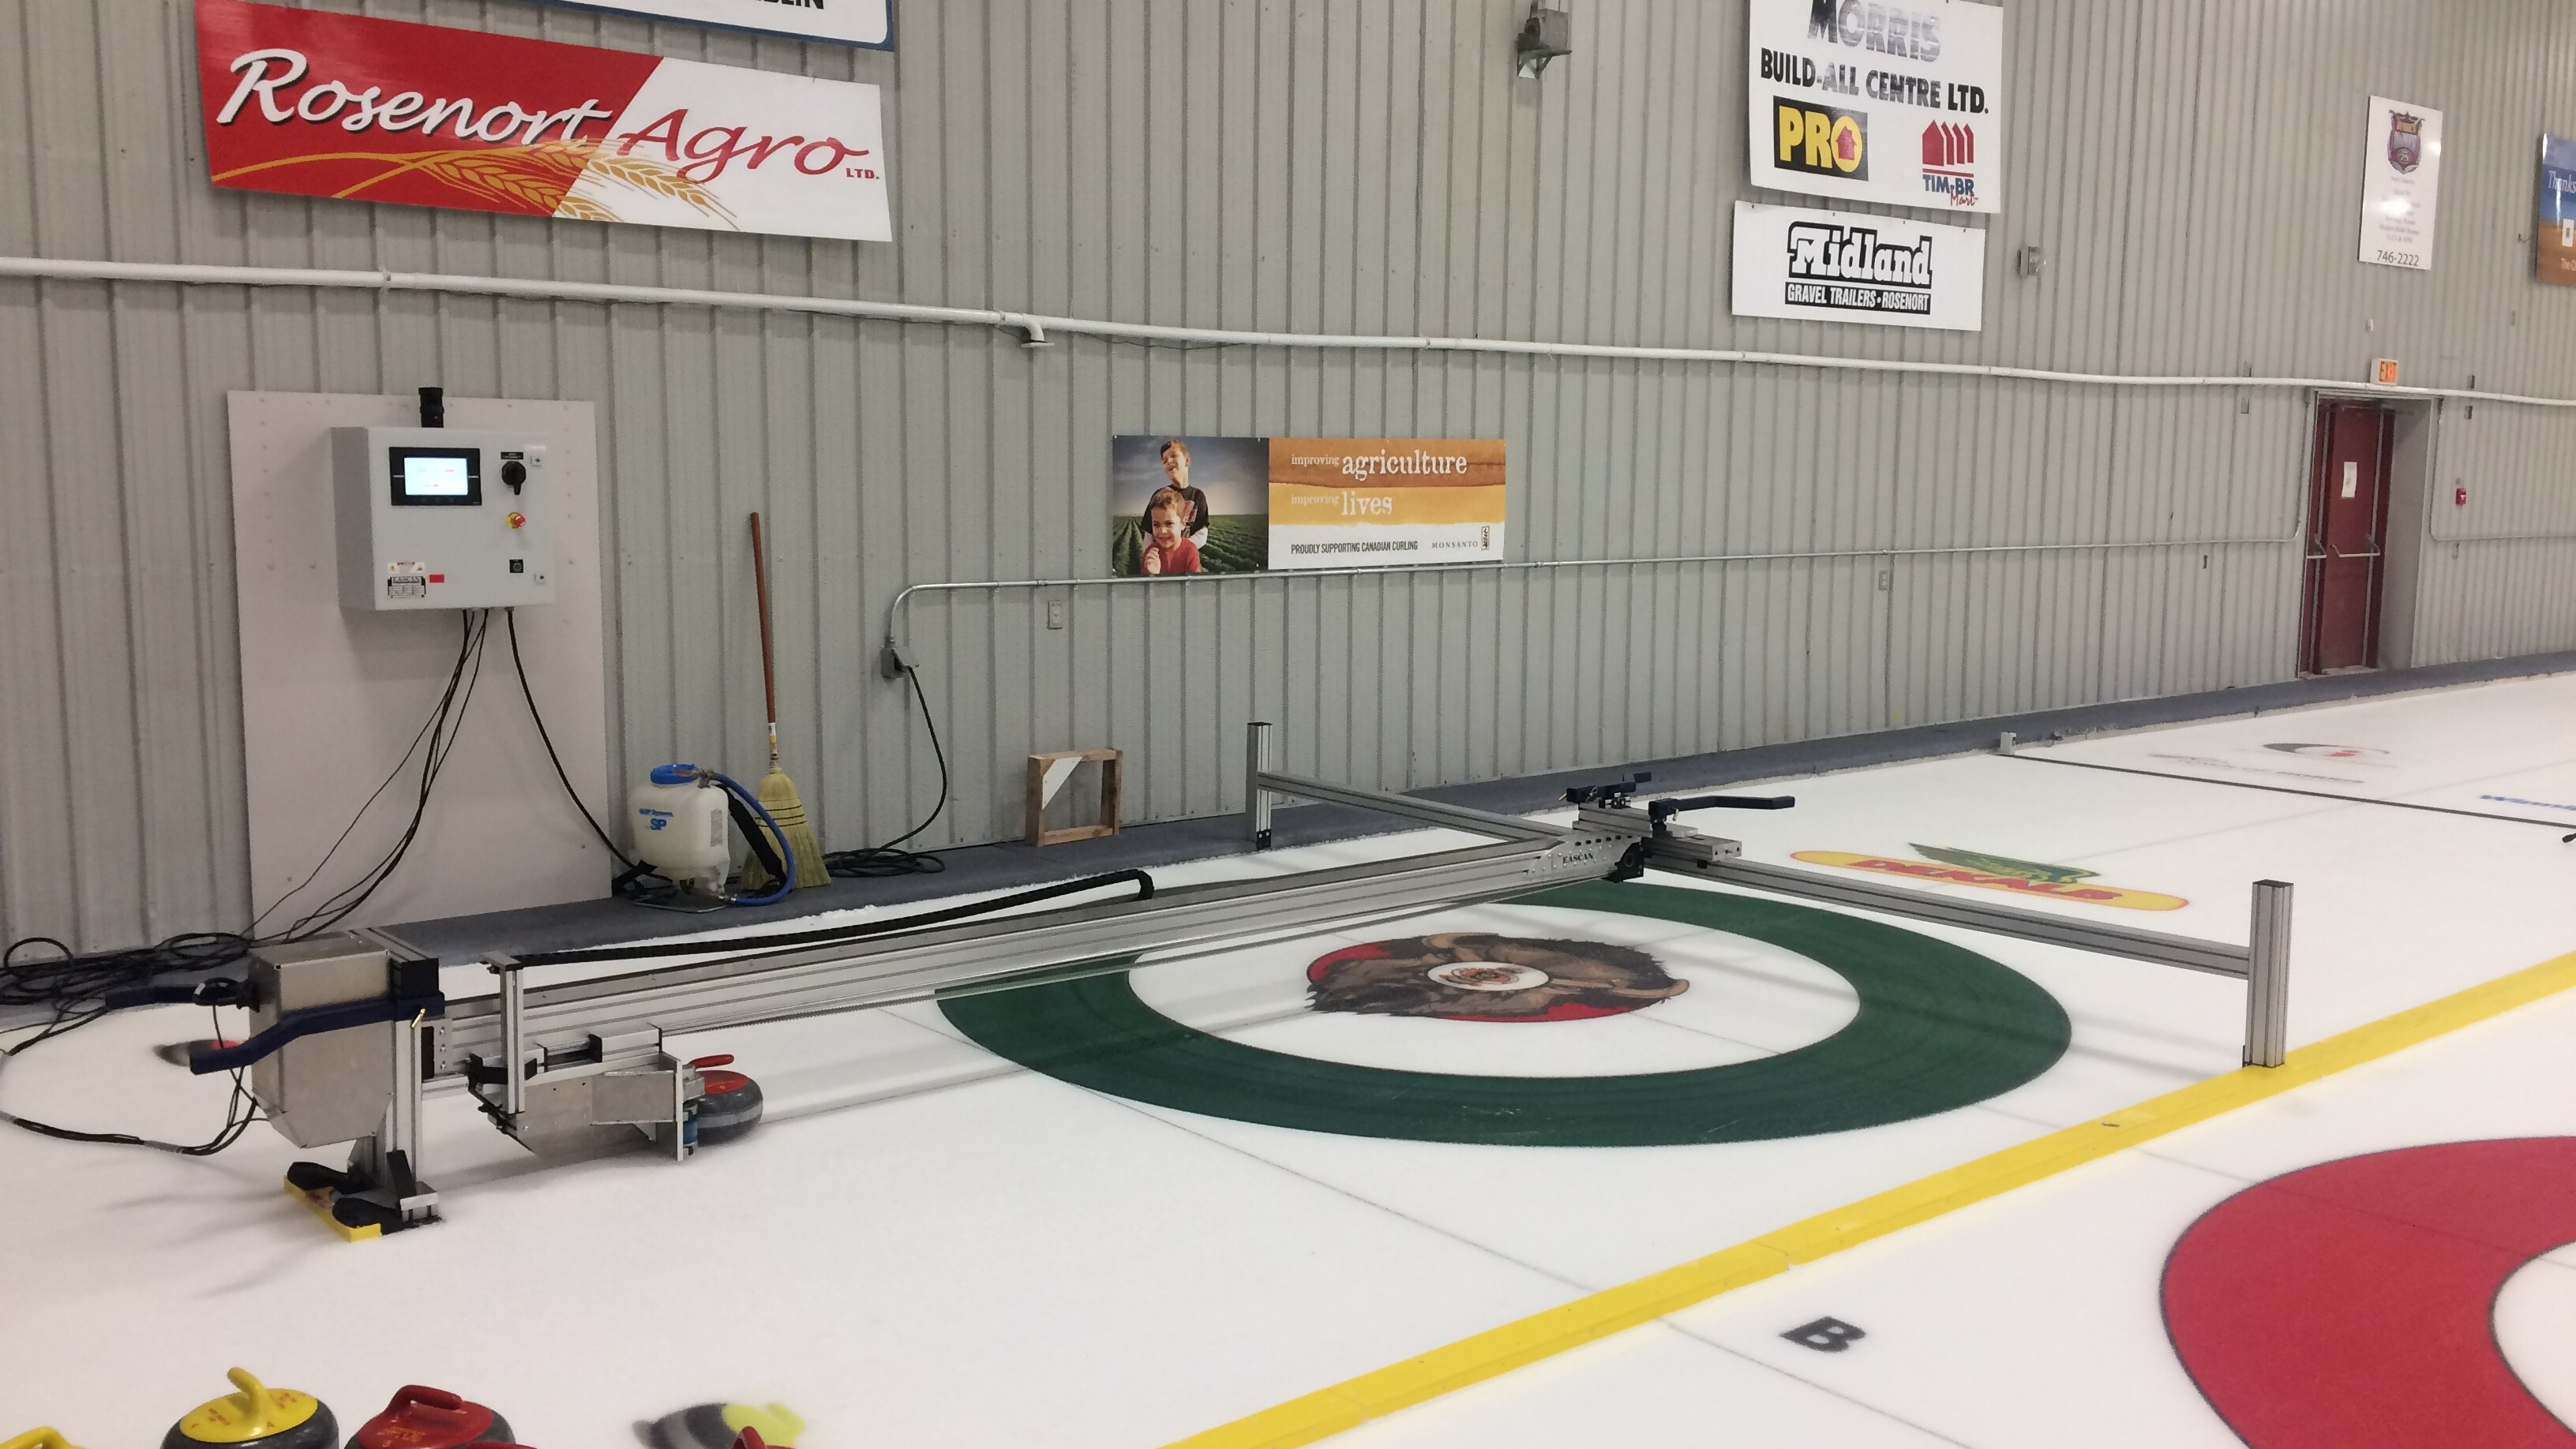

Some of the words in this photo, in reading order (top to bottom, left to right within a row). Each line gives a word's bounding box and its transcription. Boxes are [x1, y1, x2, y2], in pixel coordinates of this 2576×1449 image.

[1807, 0, 1940, 62] MORRIS
[1760, 47, 1859, 96] BUILD-ALL
[1865, 69, 1941, 109] CENTRE
[1947, 82, 1989, 114] LTD.
[216, 48, 613, 147] Rosenort
[617, 108, 869, 185] Agro
[846, 167, 880, 180] LTD.
[1779, 105, 1863, 173] PRO
[1787, 222, 1933, 288] Midland
[2377, 249, 2420, 267] 746-2222
[1787, 283, 1828, 305] GRAVEL
[1291, 454, 1340, 467] improving
[1342, 448, 1468, 481] agriculture
[1291, 494, 1340, 507] improving
[1342, 490, 1393, 515] lives
[1291, 543, 1320, 554] PROUDLY
[1321, 542, 1360, 553] SUPPORTING
[1361, 541, 1391, 552] CANADIAN
[1392, 540, 1419, 551] CURLING
[1431, 540, 1479, 549] MONSANTO
[1778, 1316, 1865, 1353] B
